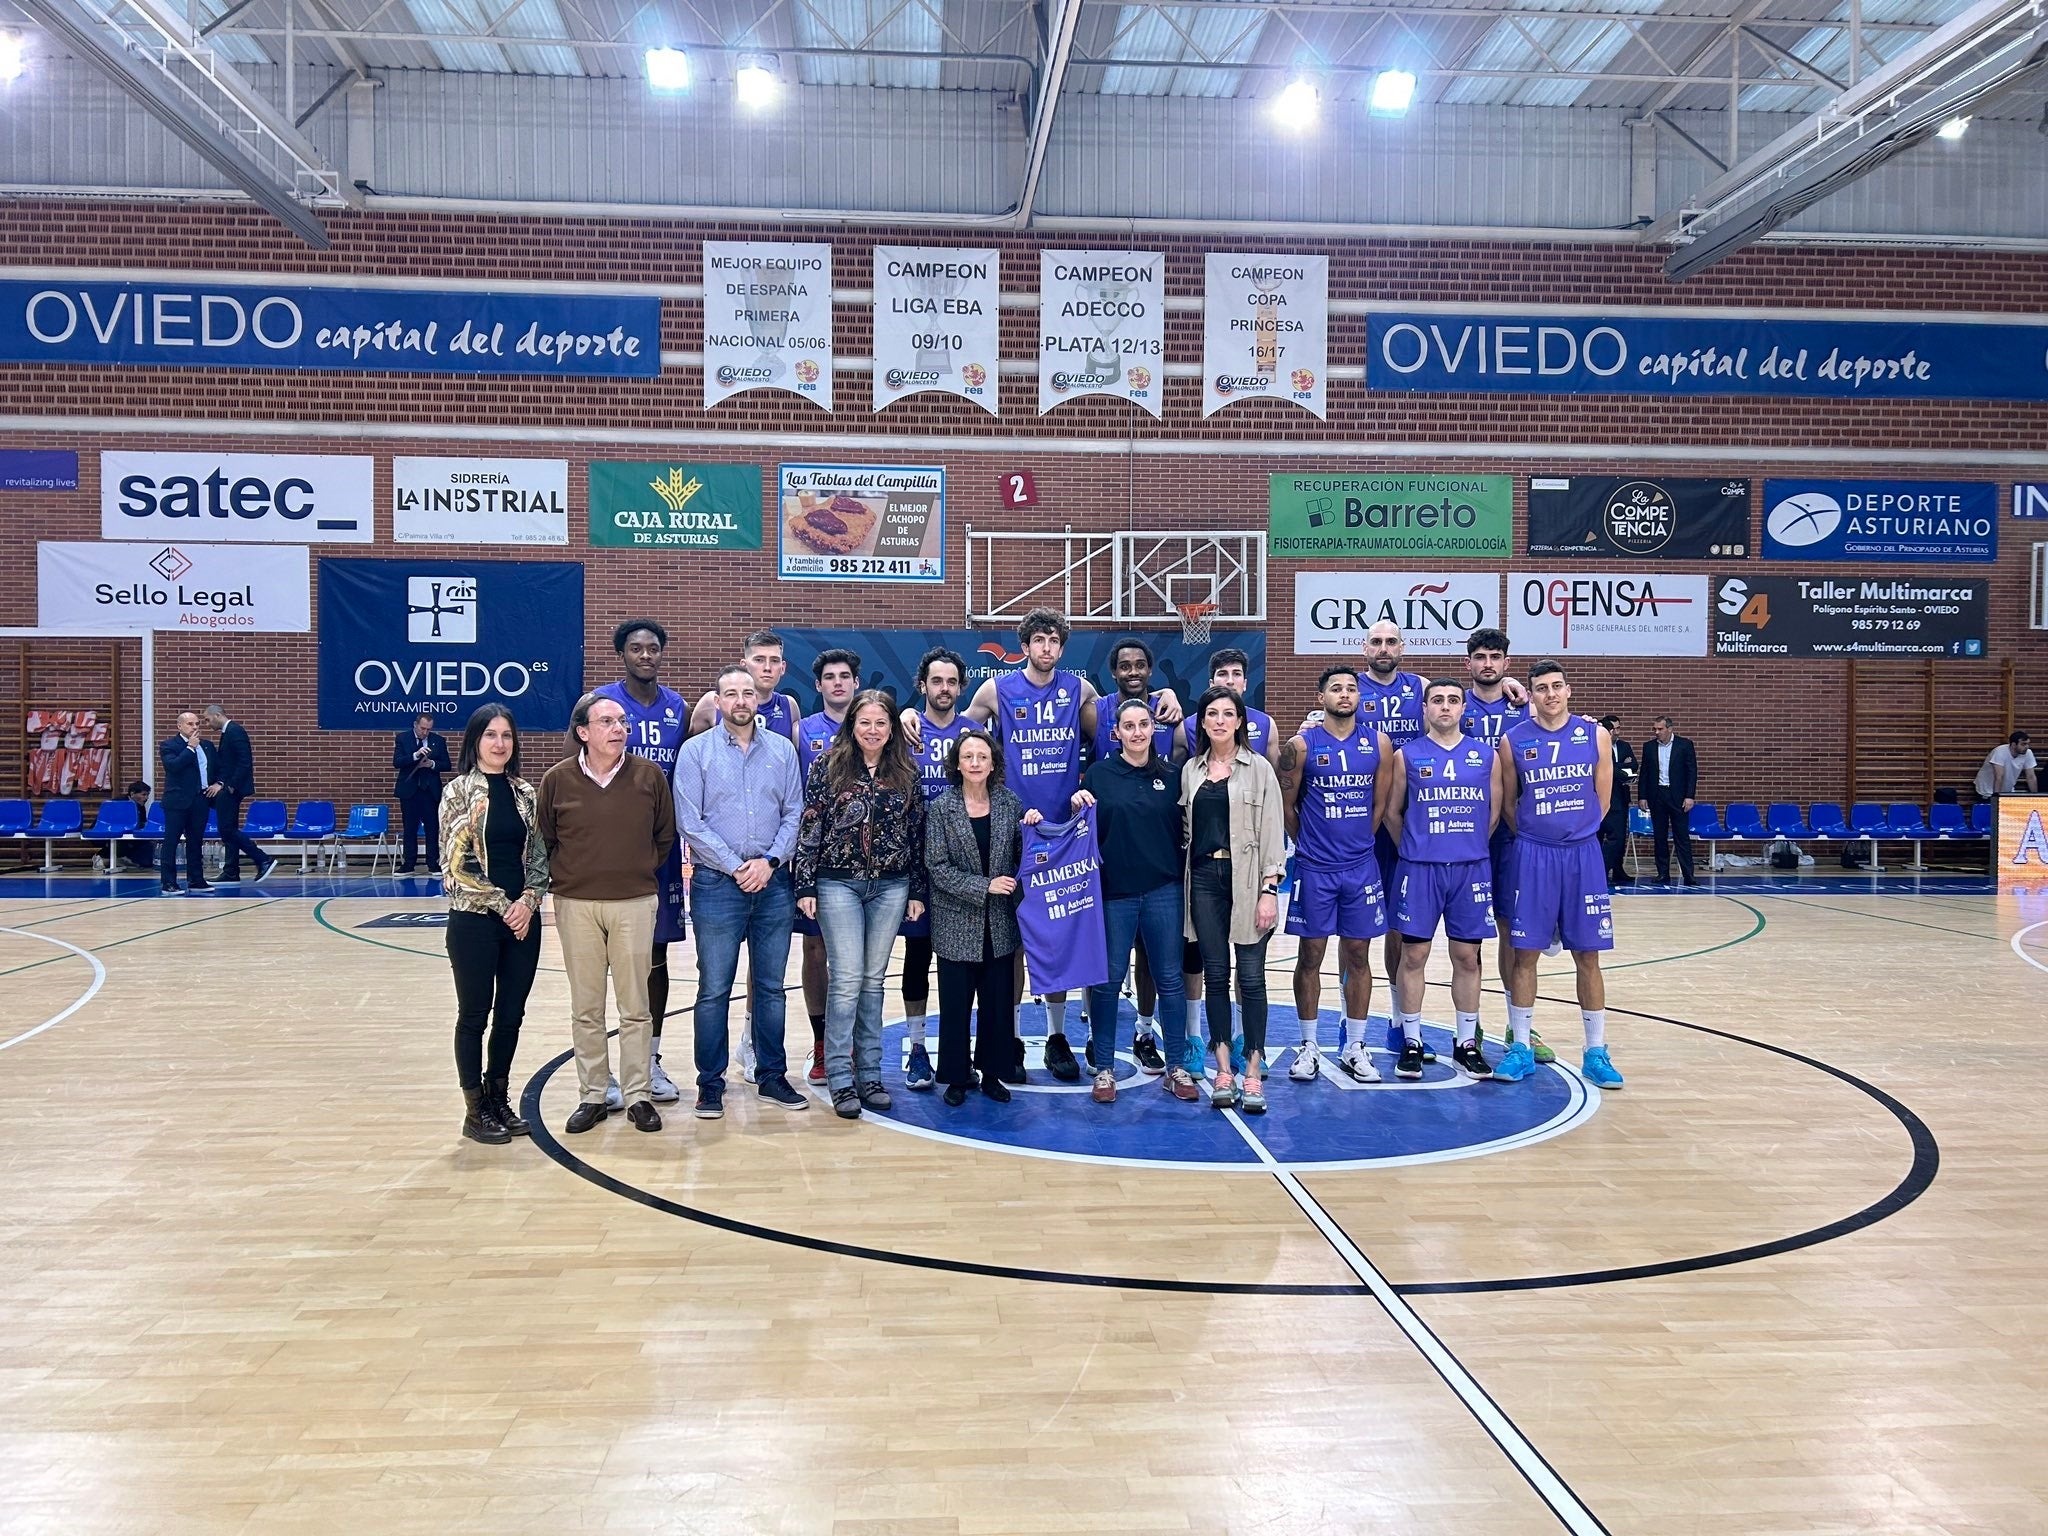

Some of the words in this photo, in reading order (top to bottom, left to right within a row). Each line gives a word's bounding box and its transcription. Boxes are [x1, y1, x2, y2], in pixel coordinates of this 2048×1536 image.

[711, 257, 761, 270] MEJOR
[766, 258, 822, 271] EQUIPO
[887, 261, 986, 279] CAMPEON
[1054, 266, 1152, 282] CAMPEON
[1231, 268, 1304, 279] CAMPEON
[726, 284, 745, 295] DE
[750, 282, 808, 296] ESPAÑA
[892, 298, 936, 313] LIGA
[943, 299, 982, 315] EBA
[1248, 294, 1287, 306] COPA
[735, 309, 800, 322] PRIMERA
[1062, 302, 1145, 318] ADECCO
[26, 291, 302, 349] OVIEDO
[316, 321, 438, 359] capital
[449, 320, 503, 357] del
[515, 324, 640, 363] deporte
[1231, 320, 1304, 332] PRINCESA
[709, 335, 784, 348] NACIONAL
[788, 337, 826, 349] 05/06
[912, 334, 962, 350] 09/10
[1045, 337, 1105, 352] PLATA
[1112, 339, 1160, 355] 12/13
[1249, 347, 1285, 358] 16/17
[1382, 324, 1628, 376] OVIEDO
[1638, 347, 1747, 388] capital
[1758, 346, 1807, 381] del
[1818, 347, 1931, 388] deporte
[720, 367, 771, 380] OVIEDO
[889, 371, 939, 383] OVIEDO
[1054, 373, 1105, 386] OVIEDO
[1219, 375, 1268, 387] OVIEDO
[5, 477, 53, 488] revitalizing
[56, 478, 76, 487] lives
[451, 472, 510, 484] SIDRERÍA
[786, 472, 808, 488] Las
[810, 473, 851, 486] Tablas
[855, 473, 872, 487] del
[876, 474, 937, 490] Campillín
[1293, 478, 1403, 492] RECUPERACIÓN
[1408, 480, 1488, 493] FUNCIONAL
[1009, 475, 1027, 502] 2
[397, 489, 419, 510] LA
[1632, 489, 1649, 505] La
[1847, 494, 1962, 513] DEPORTE
[890, 504, 898, 512] EL
[900, 504, 927, 512] MEJOR
[1345, 498, 1476, 529] Barreto
[1611, 503, 1668, 521] COMPE
[614, 511, 664, 528] CAJA
[669, 512, 737, 530] RURAL
[887, 515, 925, 524] CACHOPO
[1847, 517, 1990, 536] ASTURIANO
[898, 526, 908, 535] DE
[1612, 521, 1667, 537] TENCIA
[633, 533, 652, 544] DE
[654, 533, 718, 544] ASTURIAS
[880, 537, 919, 546] ASTURIAS
[791, 564, 824, 572] domicilio
[830, 559, 857, 573] 985
[862, 559, 884, 573] 212
[889, 560, 910, 573] 411
[95, 584, 168, 605] Sello
[178, 586, 254, 612] Legal
[1798, 581, 1854, 600] Taller
[1860, 583, 1973, 601] Multimarca
[1524, 579, 1658, 636] OGENSA
[1717, 579, 1771, 630] S4
[1813, 605, 1852, 615] Polígono
[1854, 605, 1887, 616] Espíritu
[1889, 605, 1916, 614] Santo
[1924, 606, 1959, 615] OVIEDO
[179, 613, 254, 628] Abogados
[1571, 623, 1593, 632] OBRAS
[1596, 624, 1636, 632] GENERALES
[1639, 624, 1651, 632] DEL
[1654, 624, 1676, 633] NORTE
[1679, 625, 1692, 633] S.A.
[1852, 620, 1873, 630] 985
[1875, 620, 1889, 630] 79
[1892, 620, 1903, 630] 12
[1906, 620, 1921, 631] 69
[1717, 632, 1751, 642] Taller
[1717, 642, 1787, 653] Multimarca
[1813, 642, 1944, 654] www.s4multimarca.com
[355, 701, 457, 714] AYUNTAMIENTO
[1034, 701, 1055, 724] 14
[1381, 696, 1401, 717] 12
[638, 721, 660, 745] 15
[1481, 715, 1502, 736] 17
[1010, 727, 1075, 743] ALIMERKA
[1033, 747, 1064, 756] OVIEDO
[1548, 742, 1560, 763] 7
[1338, 750, 1348, 771] 1
[1443, 759, 1456, 781] 4
[1525, 763, 1592, 784] ALIMERKA
[1417, 787, 1484, 801] ALIMERKA
[1546, 784, 1581, 794] OVIEDO
[1440, 806, 1472, 814] OVIEDO
[1555, 799, 1584, 808] Asturias
[1030, 856, 1098, 887] ALIMERKA
[1057, 880, 1089, 897] OVIEDO
[1294, 879, 1301, 901] 1
[1401, 876, 1408, 898] 4
[1068, 896, 1093, 909] Asturias
